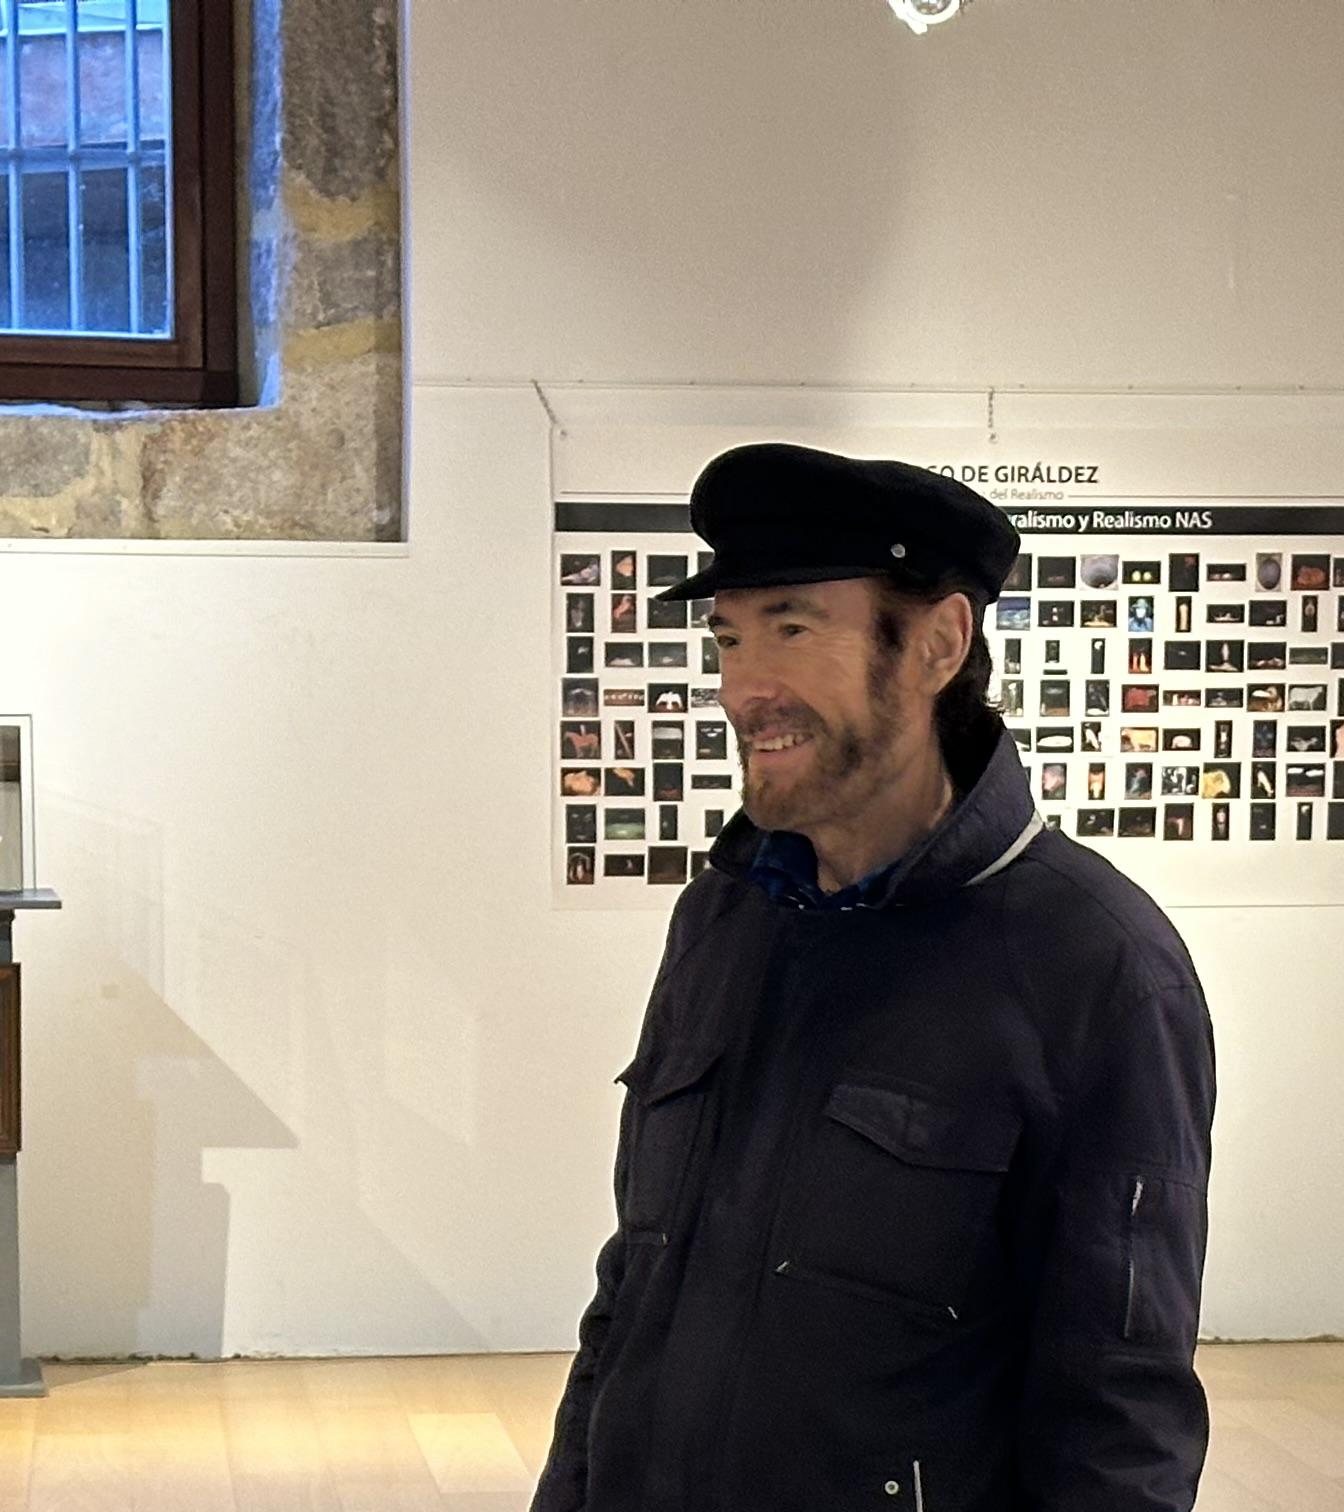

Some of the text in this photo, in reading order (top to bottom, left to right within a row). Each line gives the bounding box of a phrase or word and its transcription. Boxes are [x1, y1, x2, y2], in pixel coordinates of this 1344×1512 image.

[961, 465, 989, 482] DE
[994, 461, 1099, 484] GIRÁLDEZ
[989, 488, 1064, 501] del Realismo
[1009, 510, 1213, 532] ralismo y Realismo NAS
